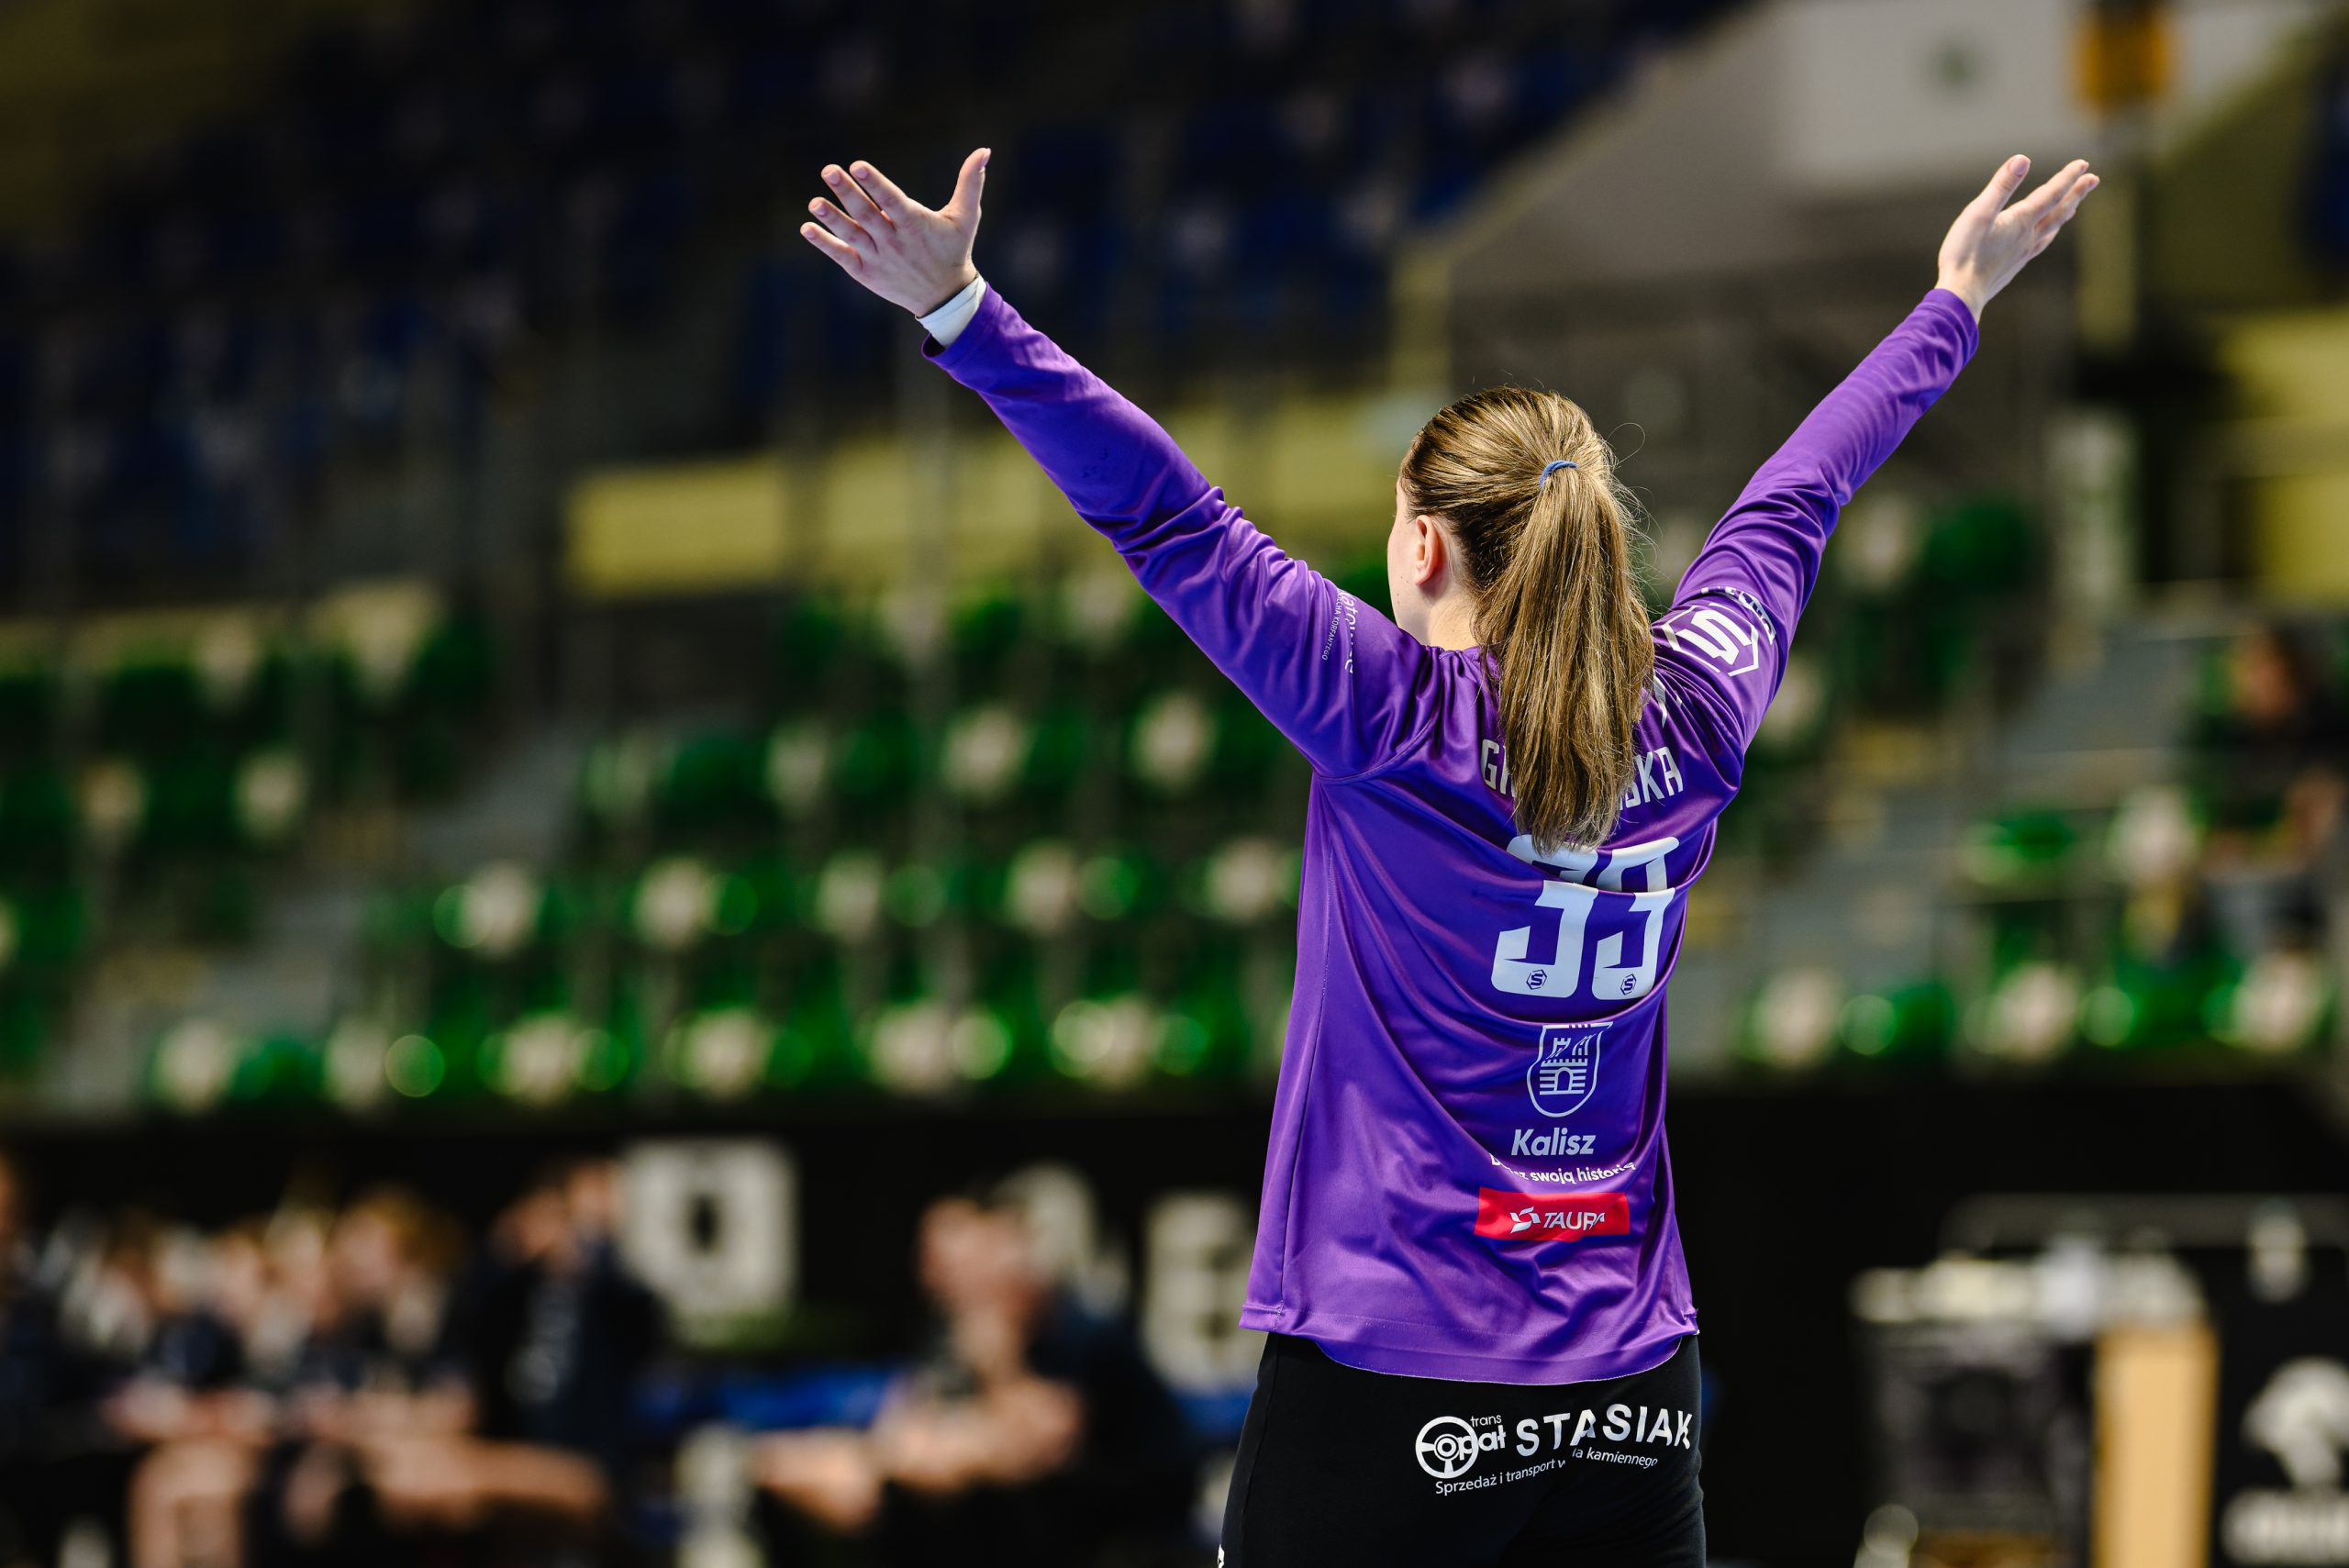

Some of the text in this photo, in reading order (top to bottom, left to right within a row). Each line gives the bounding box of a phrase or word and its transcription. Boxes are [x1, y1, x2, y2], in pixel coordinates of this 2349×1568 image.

[1510, 1127, 1597, 1157] Kalisz
[1530, 1167, 1576, 1184] swoją
[1470, 1412, 1502, 1428] trans
[1516, 1403, 1693, 1457] STASIAK
[1435, 1473, 1497, 1496] Sprzedaż
[1499, 1473, 1504, 1485] i
[1506, 1459, 1556, 1483] transport
[1586, 1447, 1658, 1470] kamiennego
